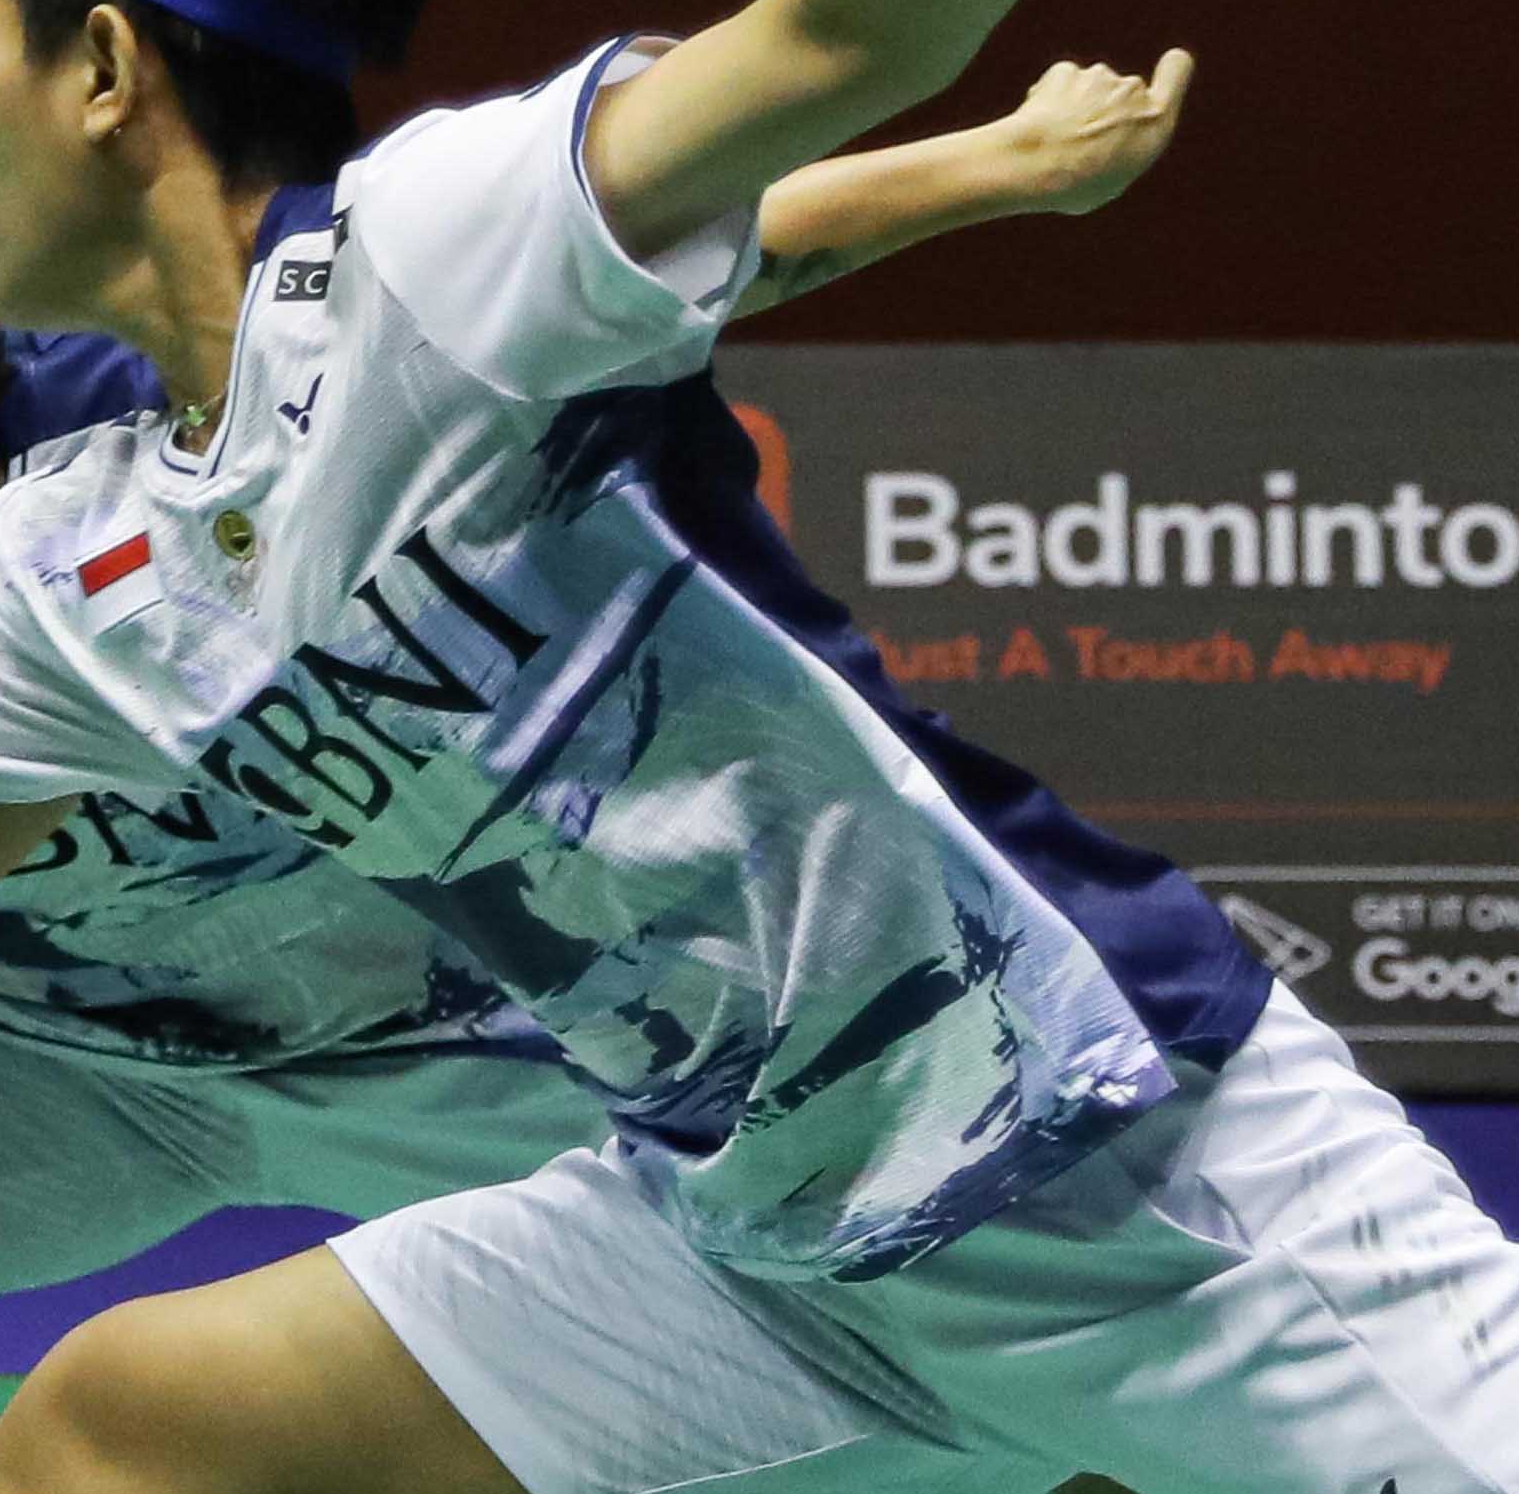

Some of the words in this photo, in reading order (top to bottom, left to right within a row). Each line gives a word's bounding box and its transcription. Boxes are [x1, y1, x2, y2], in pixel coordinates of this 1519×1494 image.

[998, 627, 1051, 681] A
[1068, 626, 1257, 682] Touch
[1267, 626, 1451, 697] Away
